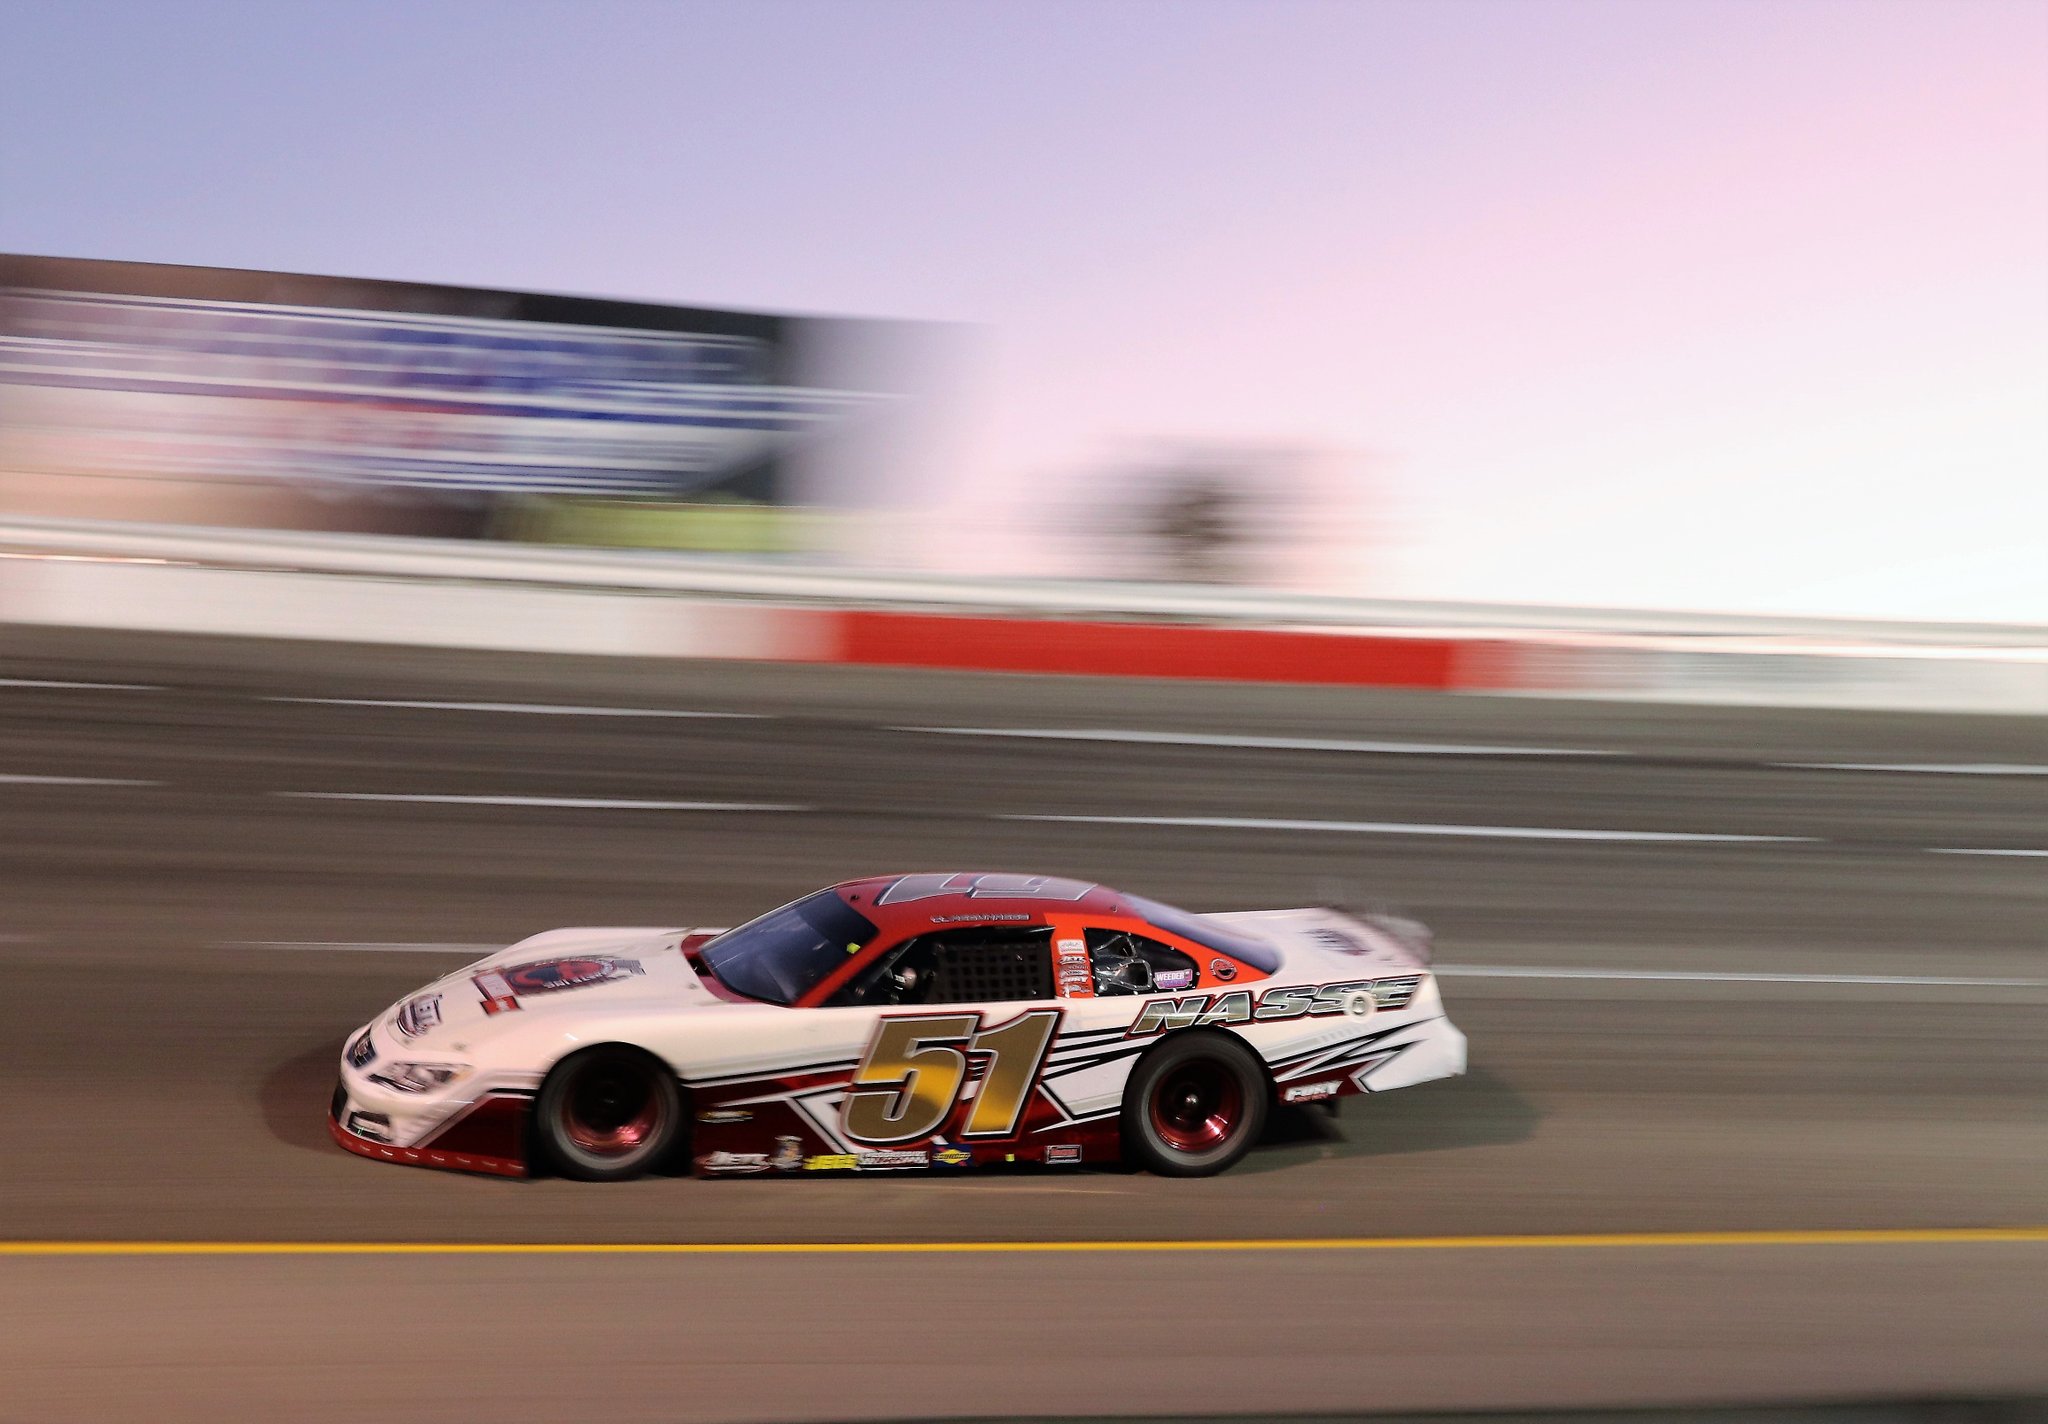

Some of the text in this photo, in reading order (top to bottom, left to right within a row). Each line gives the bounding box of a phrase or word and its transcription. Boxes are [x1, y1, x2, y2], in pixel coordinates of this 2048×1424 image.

[1130, 974, 1423, 1035] NASSE
[1156, 972, 1185, 982] WEEDER
[840, 1010, 1060, 1144] 51
